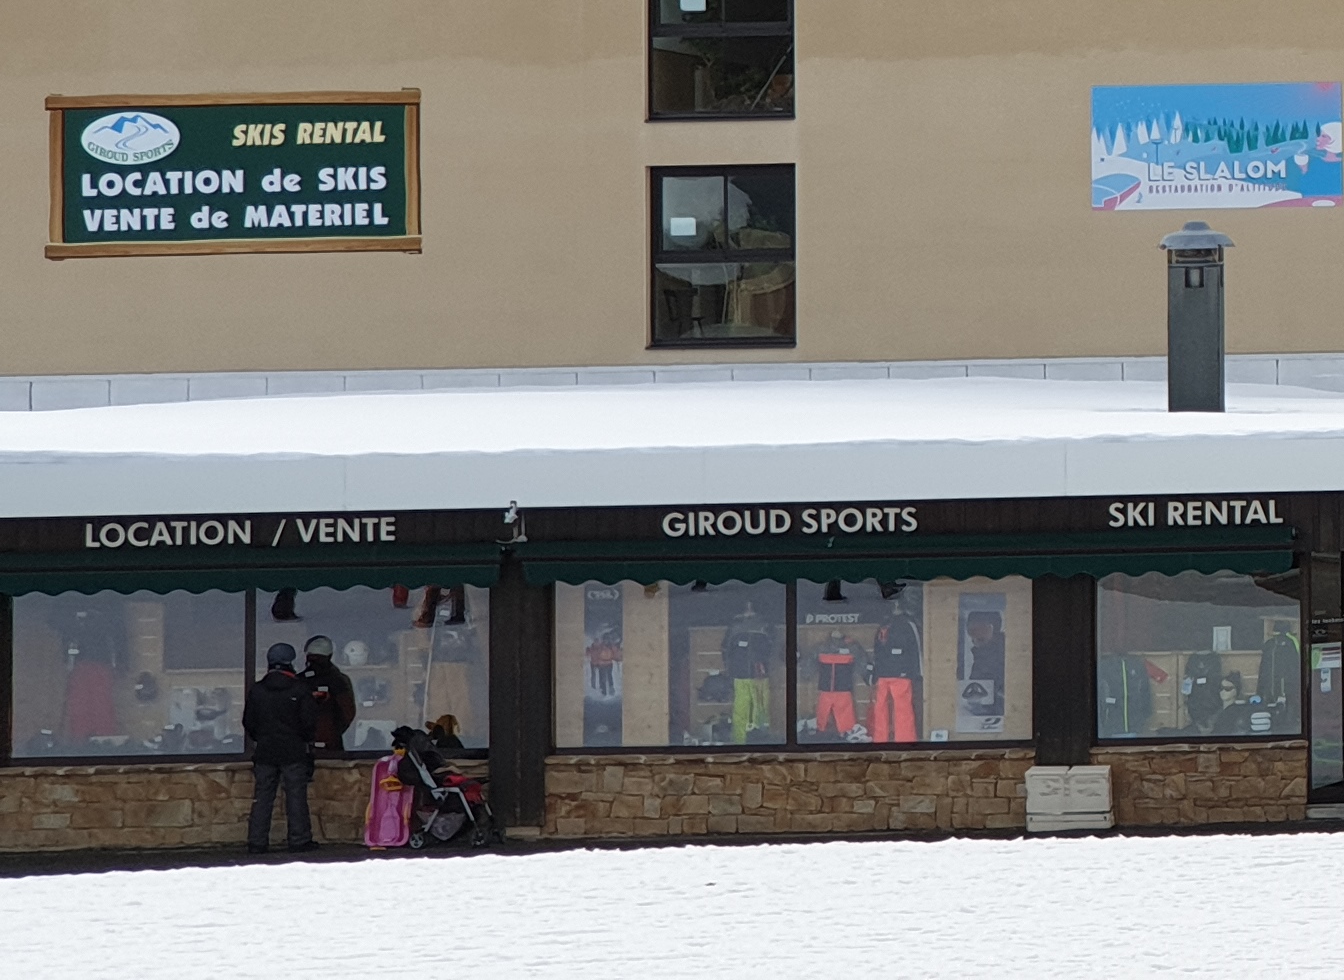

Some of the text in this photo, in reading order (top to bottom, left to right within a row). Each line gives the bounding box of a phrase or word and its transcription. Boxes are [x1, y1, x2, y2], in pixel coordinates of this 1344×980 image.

[232, 121, 386, 147] SKIS RENTAL
[87, 139, 174, 162] GIROUD SPORTS
[81, 166, 387, 197] LOCATION de SKIS
[1148, 159, 1287, 182] LE SLALOM
[83, 202, 389, 232] VENTE de MATERIEL
[662, 507, 918, 538] GIROUD SPORTS
[1108, 499, 1283, 528] SKI RENTAL
[84, 518, 253, 548] LOCATION
[296, 516, 396, 544] VENTE
[815, 613, 860, 624] PROTEST
